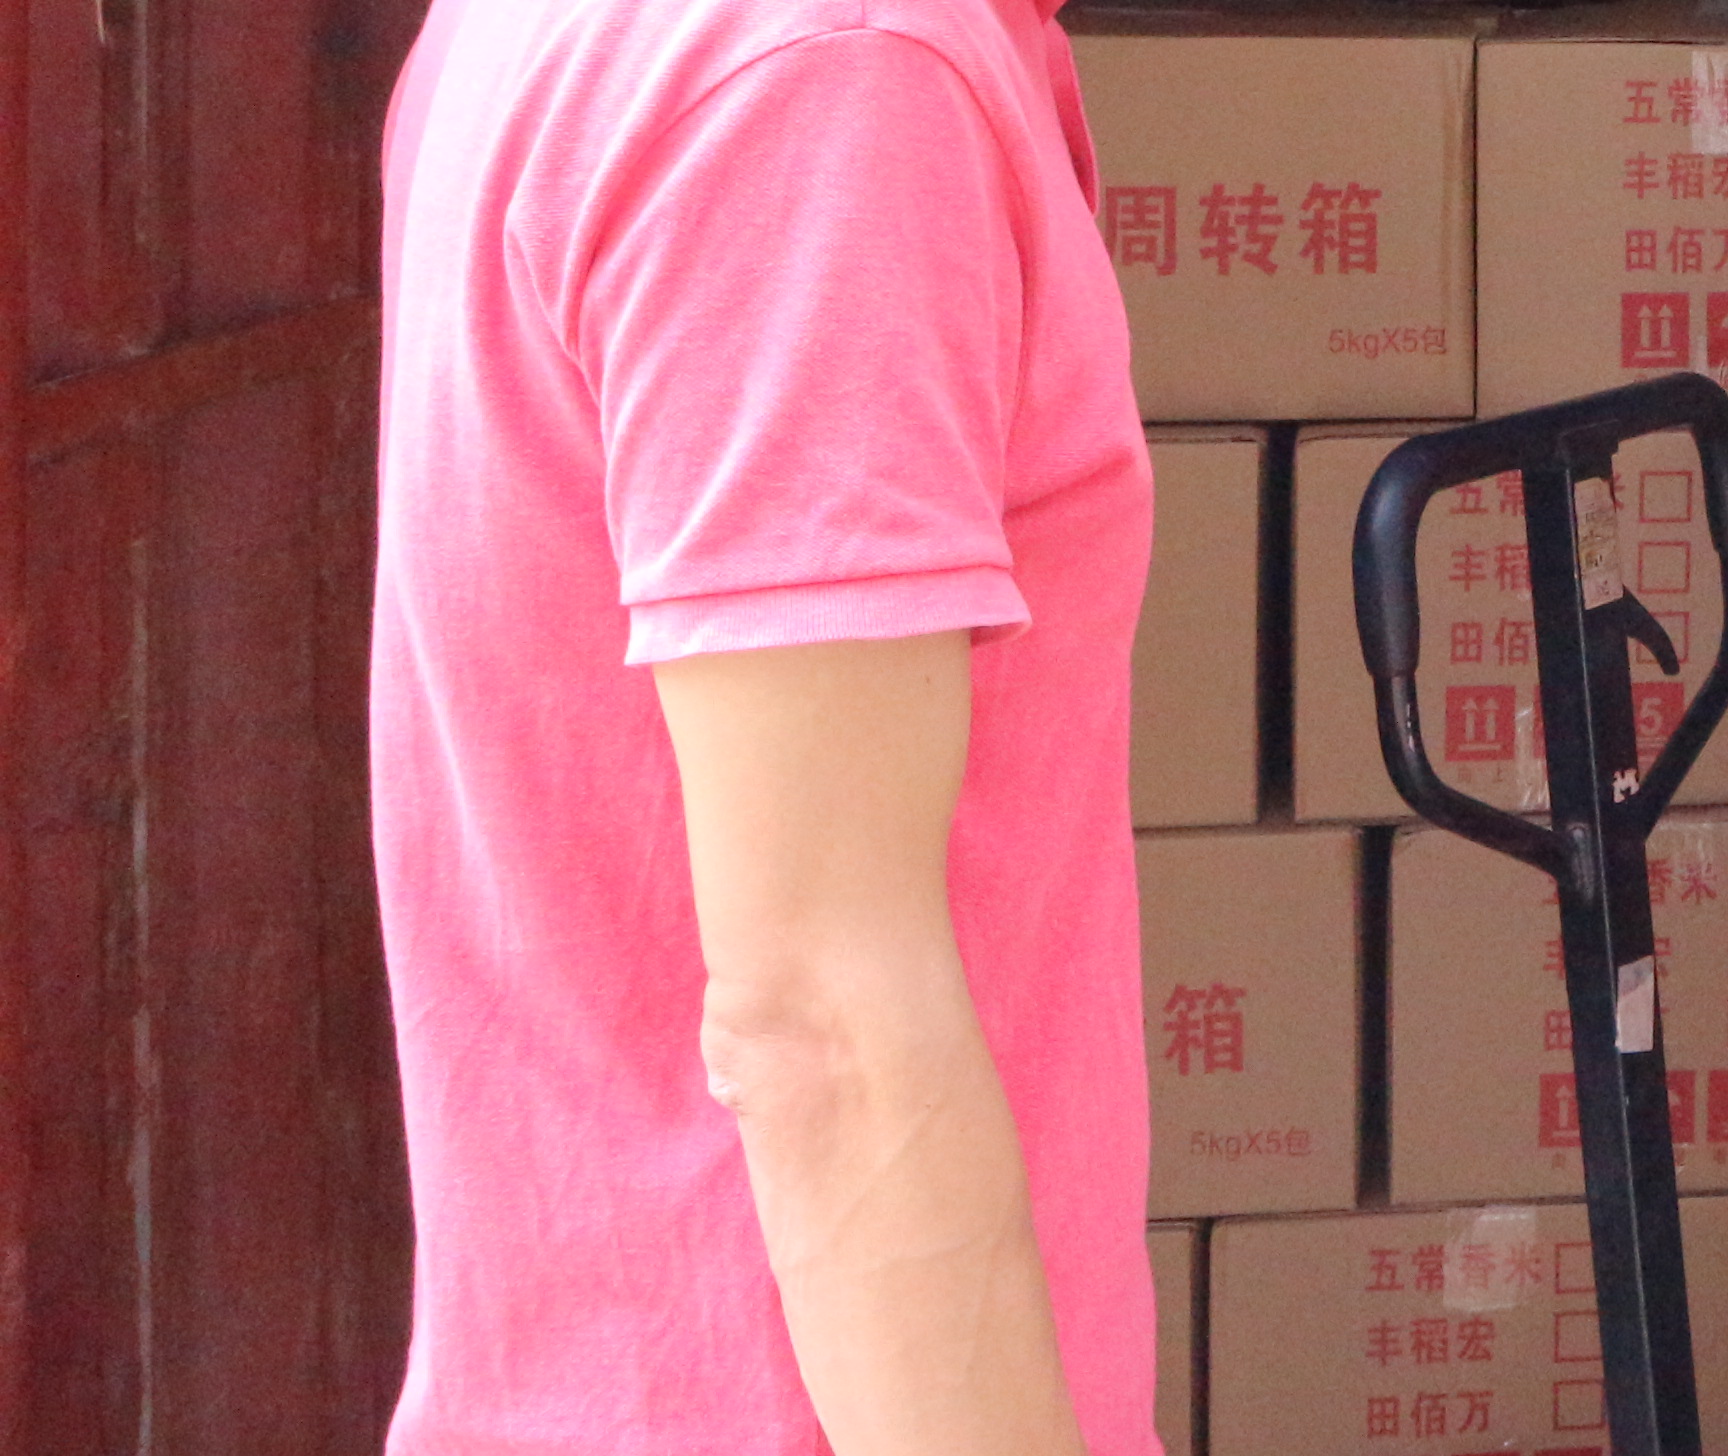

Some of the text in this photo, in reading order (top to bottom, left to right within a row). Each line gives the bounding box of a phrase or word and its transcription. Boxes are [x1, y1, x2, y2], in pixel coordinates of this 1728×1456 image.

[1327, 325, 1449, 360] 5kgX5包
[1162, 982, 1246, 1076] 箱
[1365, 1244, 1545, 1293] 五常香米
[1366, 1315, 1496, 1366] 丰稻宏
[1366, 1389, 1495, 1439] 田佰万
